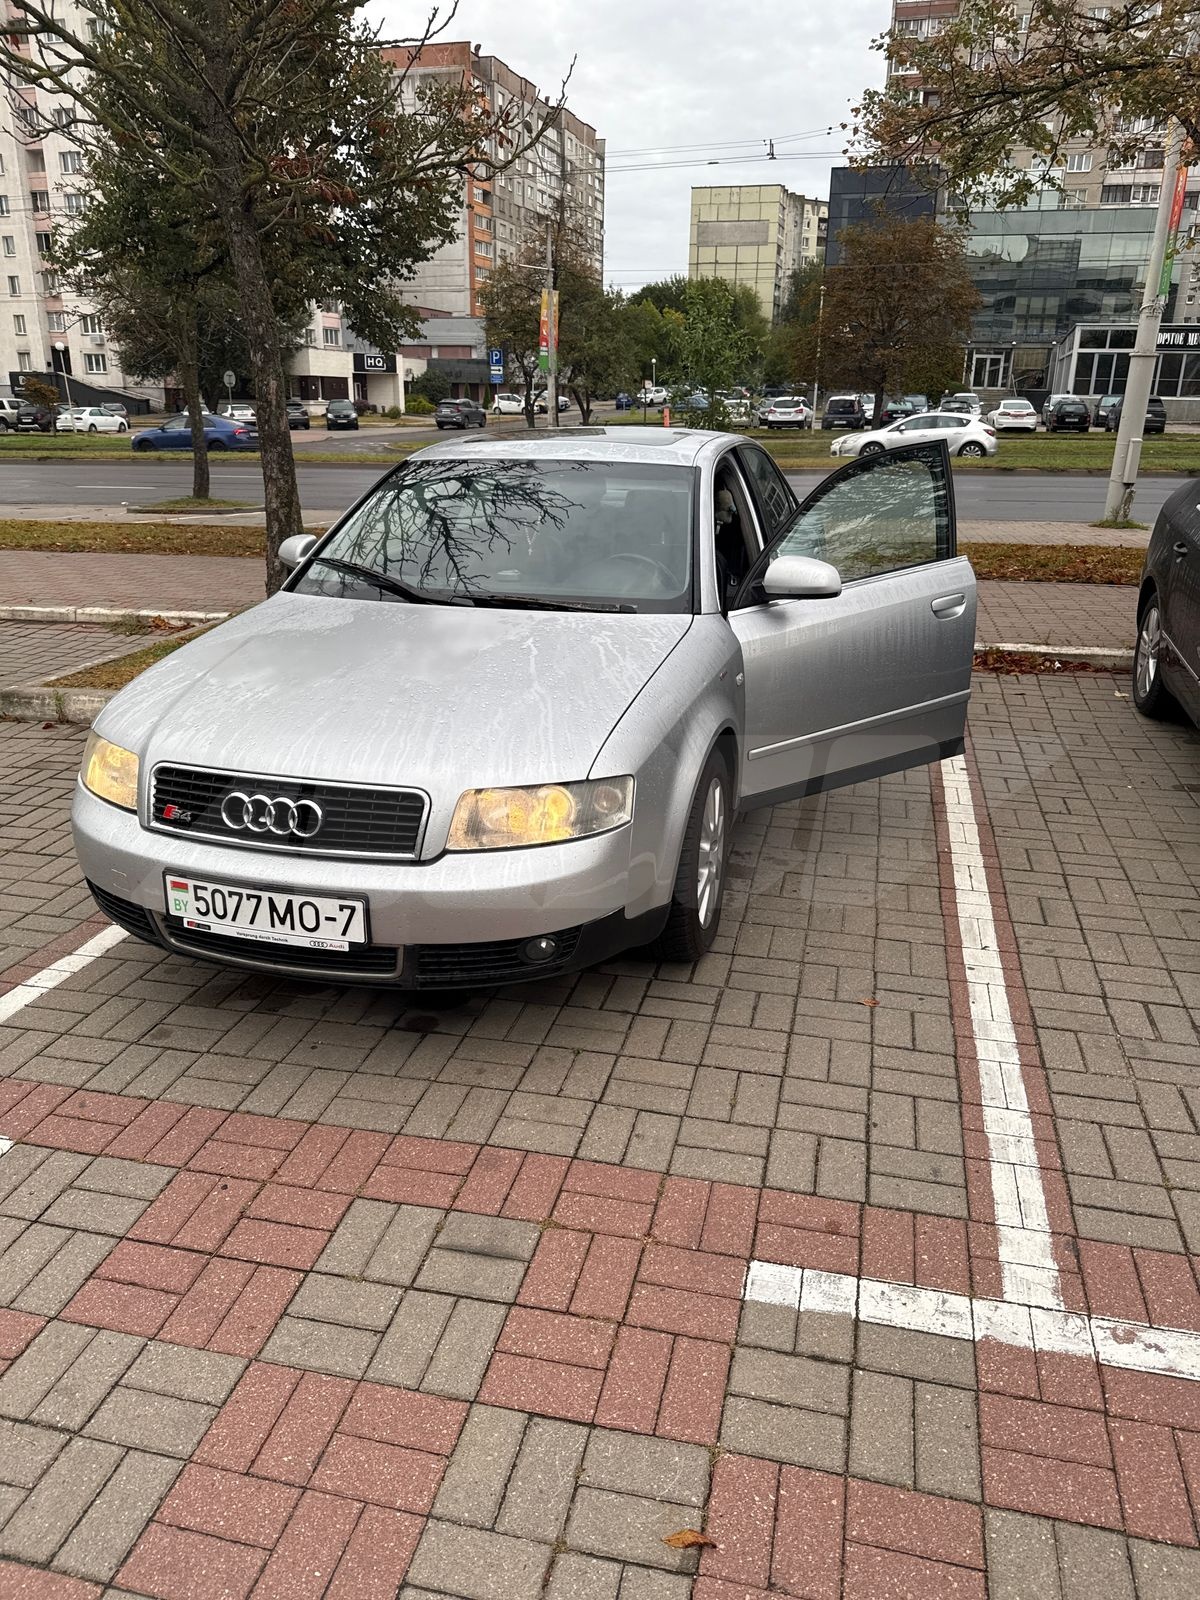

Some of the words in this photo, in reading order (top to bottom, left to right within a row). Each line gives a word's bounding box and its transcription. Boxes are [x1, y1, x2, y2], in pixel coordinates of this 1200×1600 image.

[1186, 332, 1200, 346] МЕ
[367, 357, 383, 367] HQ
[492, 351, 500, 364] P
[174, 898, 189, 912] BY
